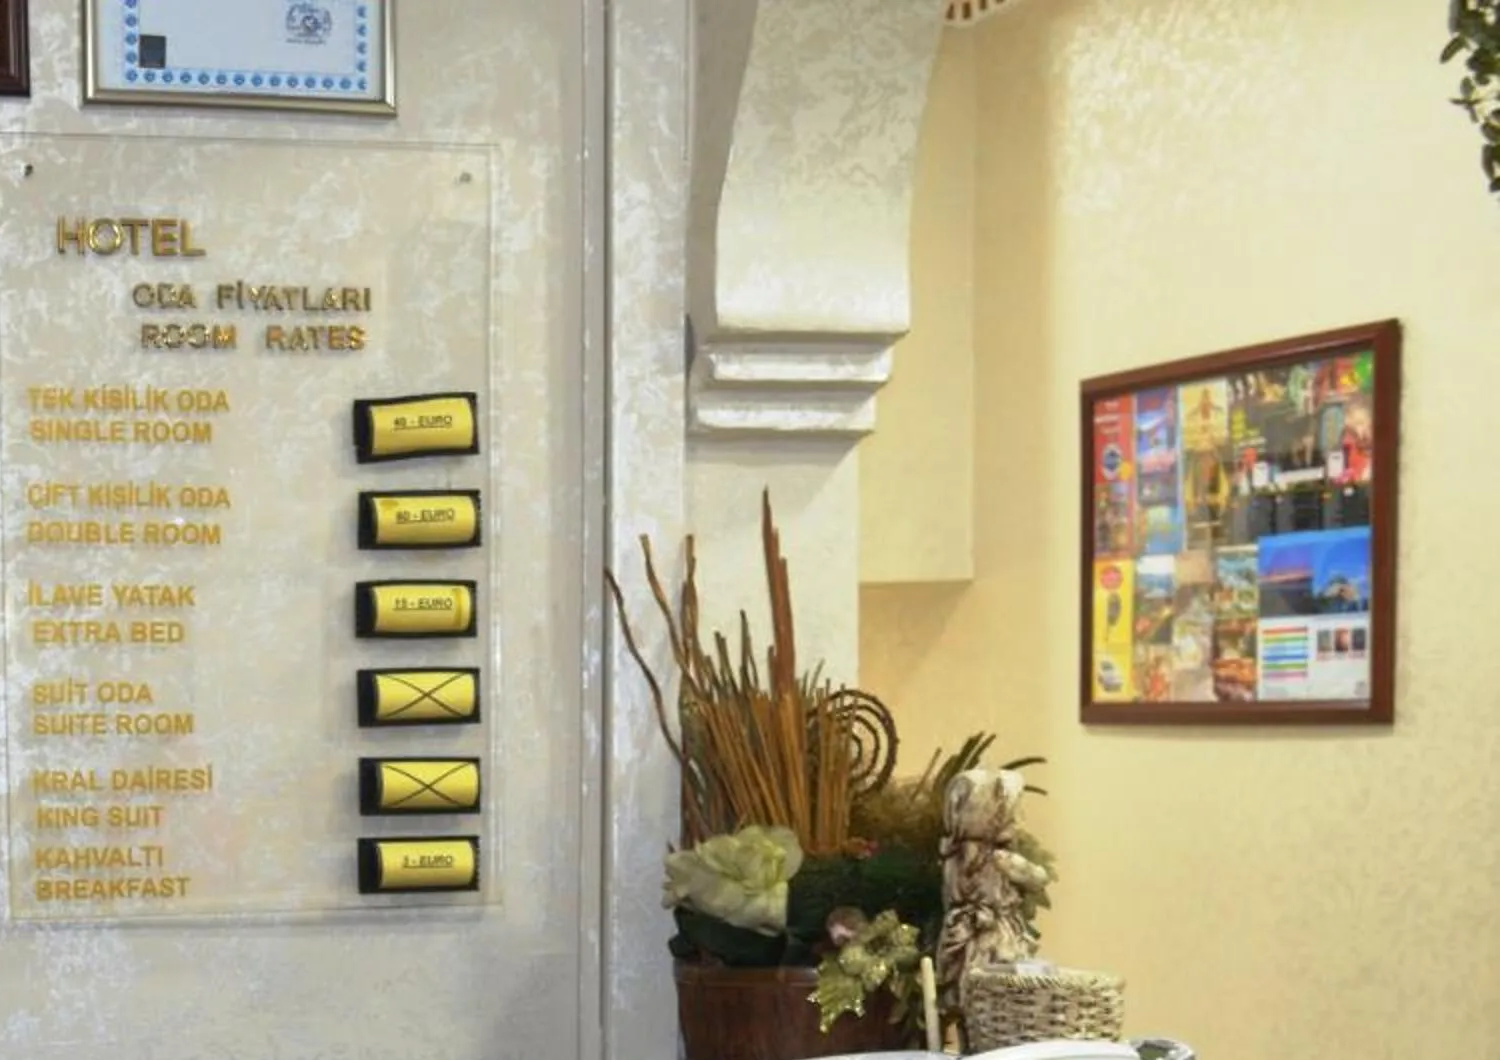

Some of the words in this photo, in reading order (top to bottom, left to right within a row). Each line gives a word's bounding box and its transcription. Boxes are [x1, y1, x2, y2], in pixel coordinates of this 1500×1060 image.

[56, 216, 207, 257] HOTEL
[132, 283, 197, 310] ODA
[216, 280, 371, 312] FİYATLARI
[140, 324, 237, 350] ROOM
[265, 325, 367, 351] RATES
[177, 389, 230, 412] ODA
[29, 418, 126, 442] SINGLE
[133, 420, 213, 443] ROOM
[179, 486, 231, 509] ODA
[27, 521, 135, 544] DOUBLE
[144, 522, 222, 545] ROOM
[111, 584, 196, 607] YATAK
[32, 620, 121, 644] EXTRA
[130, 621, 185, 643] BED
[96, 681, 153, 704] ODA
[32, 713, 108, 736] SUITE
[115, 713, 194, 735] ROOM
[32, 769, 103, 792] KRAL
[35, 806, 100, 830] KING
[107, 805, 166, 828] SUIT
[34, 845, 164, 869] KAHVALTI
[35, 876, 191, 901] BREAKFAST
